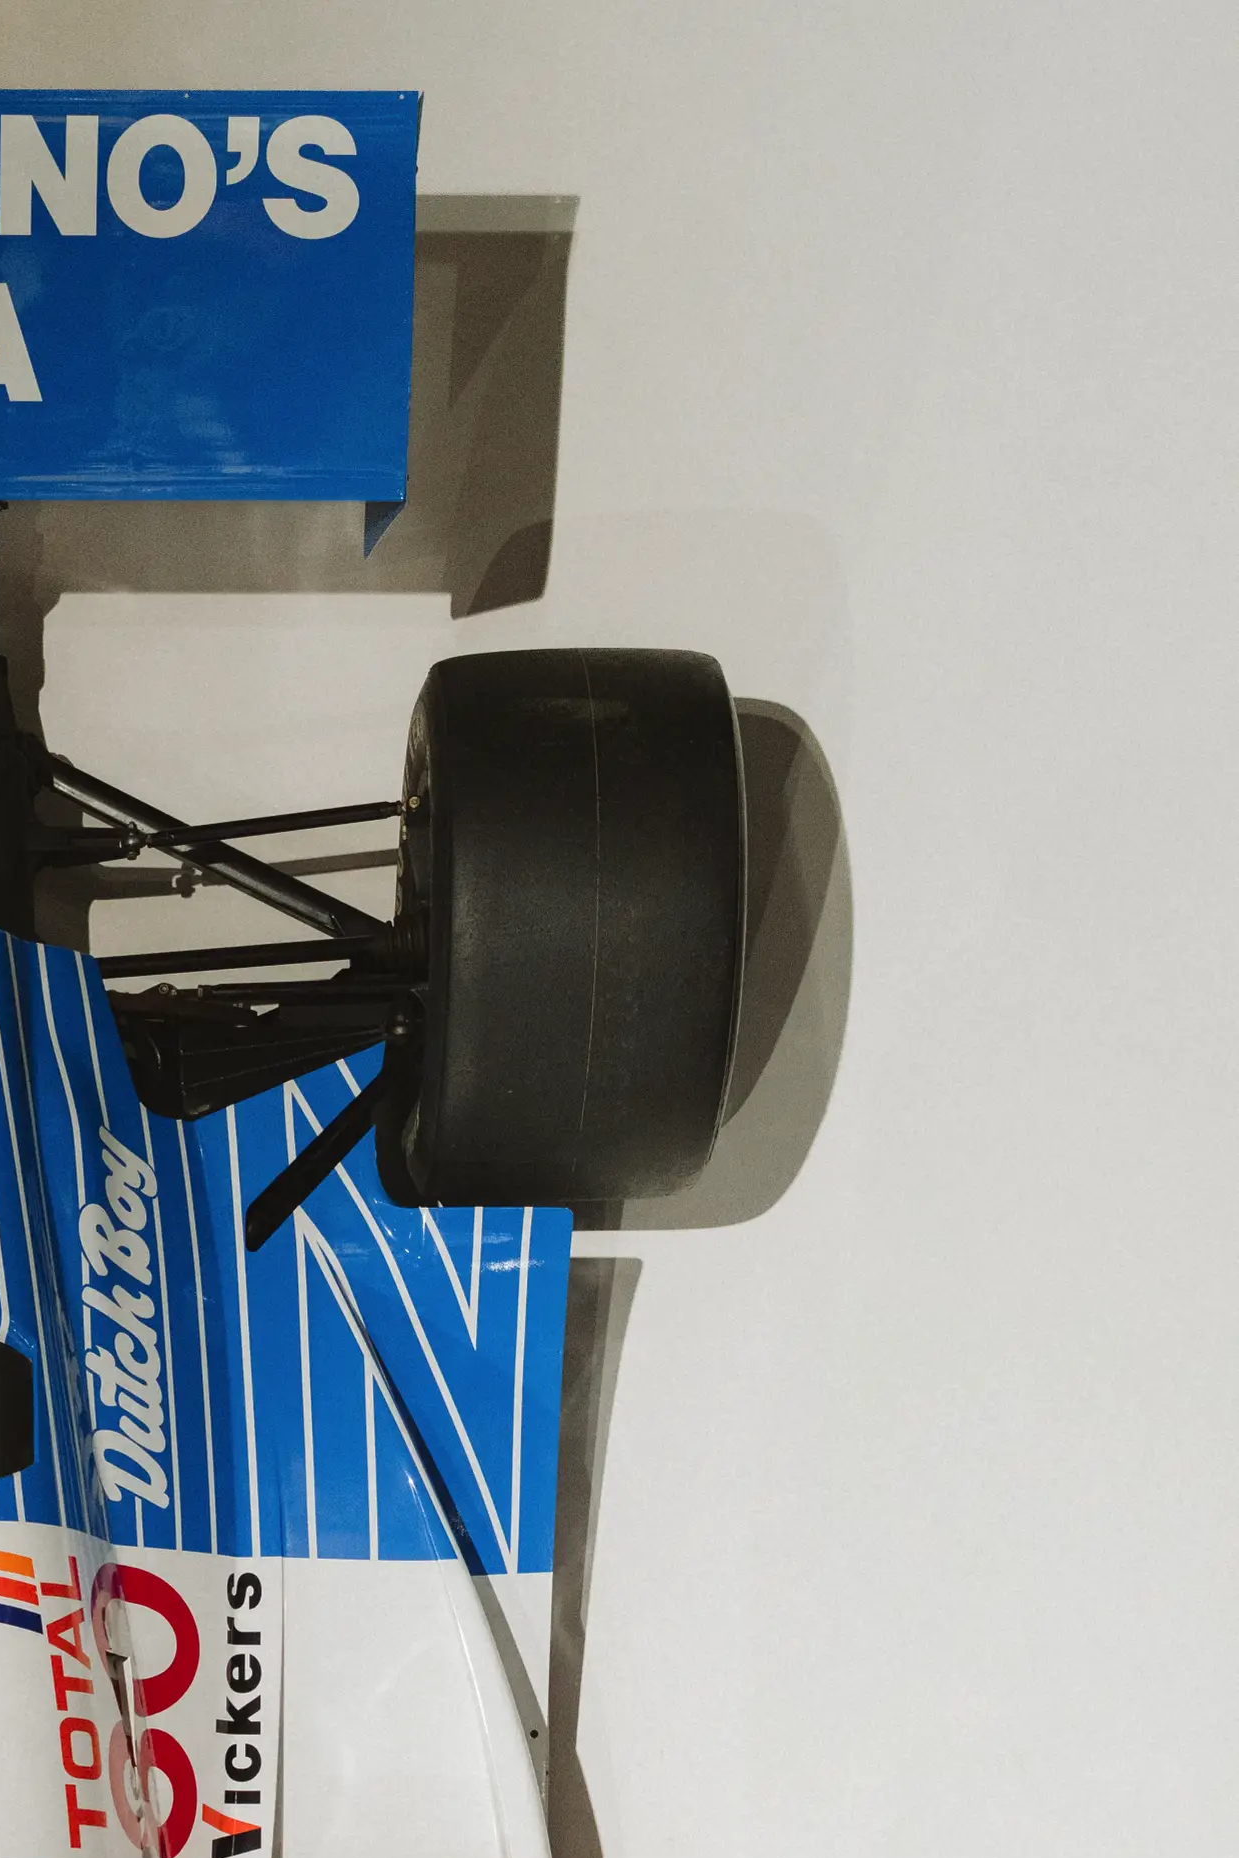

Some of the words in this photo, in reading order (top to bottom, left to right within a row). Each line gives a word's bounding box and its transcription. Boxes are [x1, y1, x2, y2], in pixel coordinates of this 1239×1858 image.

[79, 1126, 157, 1286] Boy
[81, 1285, 169, 1509] Dutch
[40, 1555, 108, 1849] TOTAL
